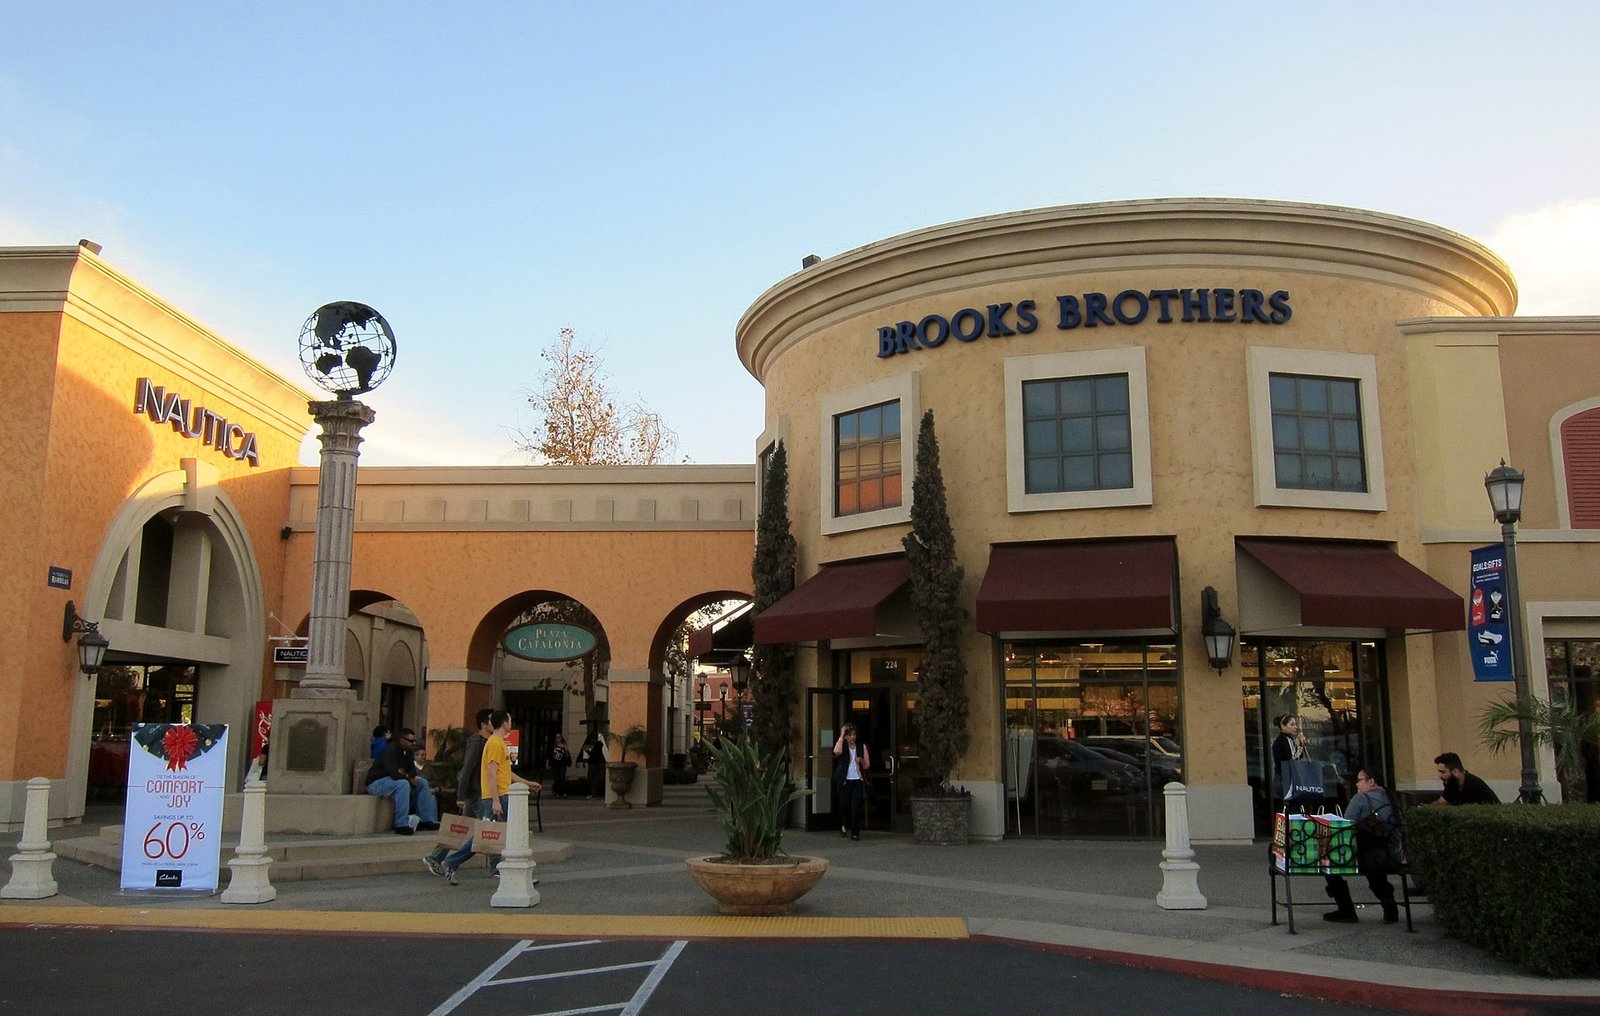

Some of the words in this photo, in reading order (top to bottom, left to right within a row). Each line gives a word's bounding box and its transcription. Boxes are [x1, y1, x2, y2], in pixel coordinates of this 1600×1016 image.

[876, 299, 1039, 359] BROOKS
[1056, 288, 1294, 330] BROTHERS
[133, 377, 260, 467] NAUTICA
[535, 628, 567, 639] PLAZA
[518, 637, 582, 651] CATALONIA
[885, 660, 898, 669] 224
[146, 780, 205, 794] COMFORT
[167, 795, 191, 808] JOY
[143, 822, 205, 859] 60%
